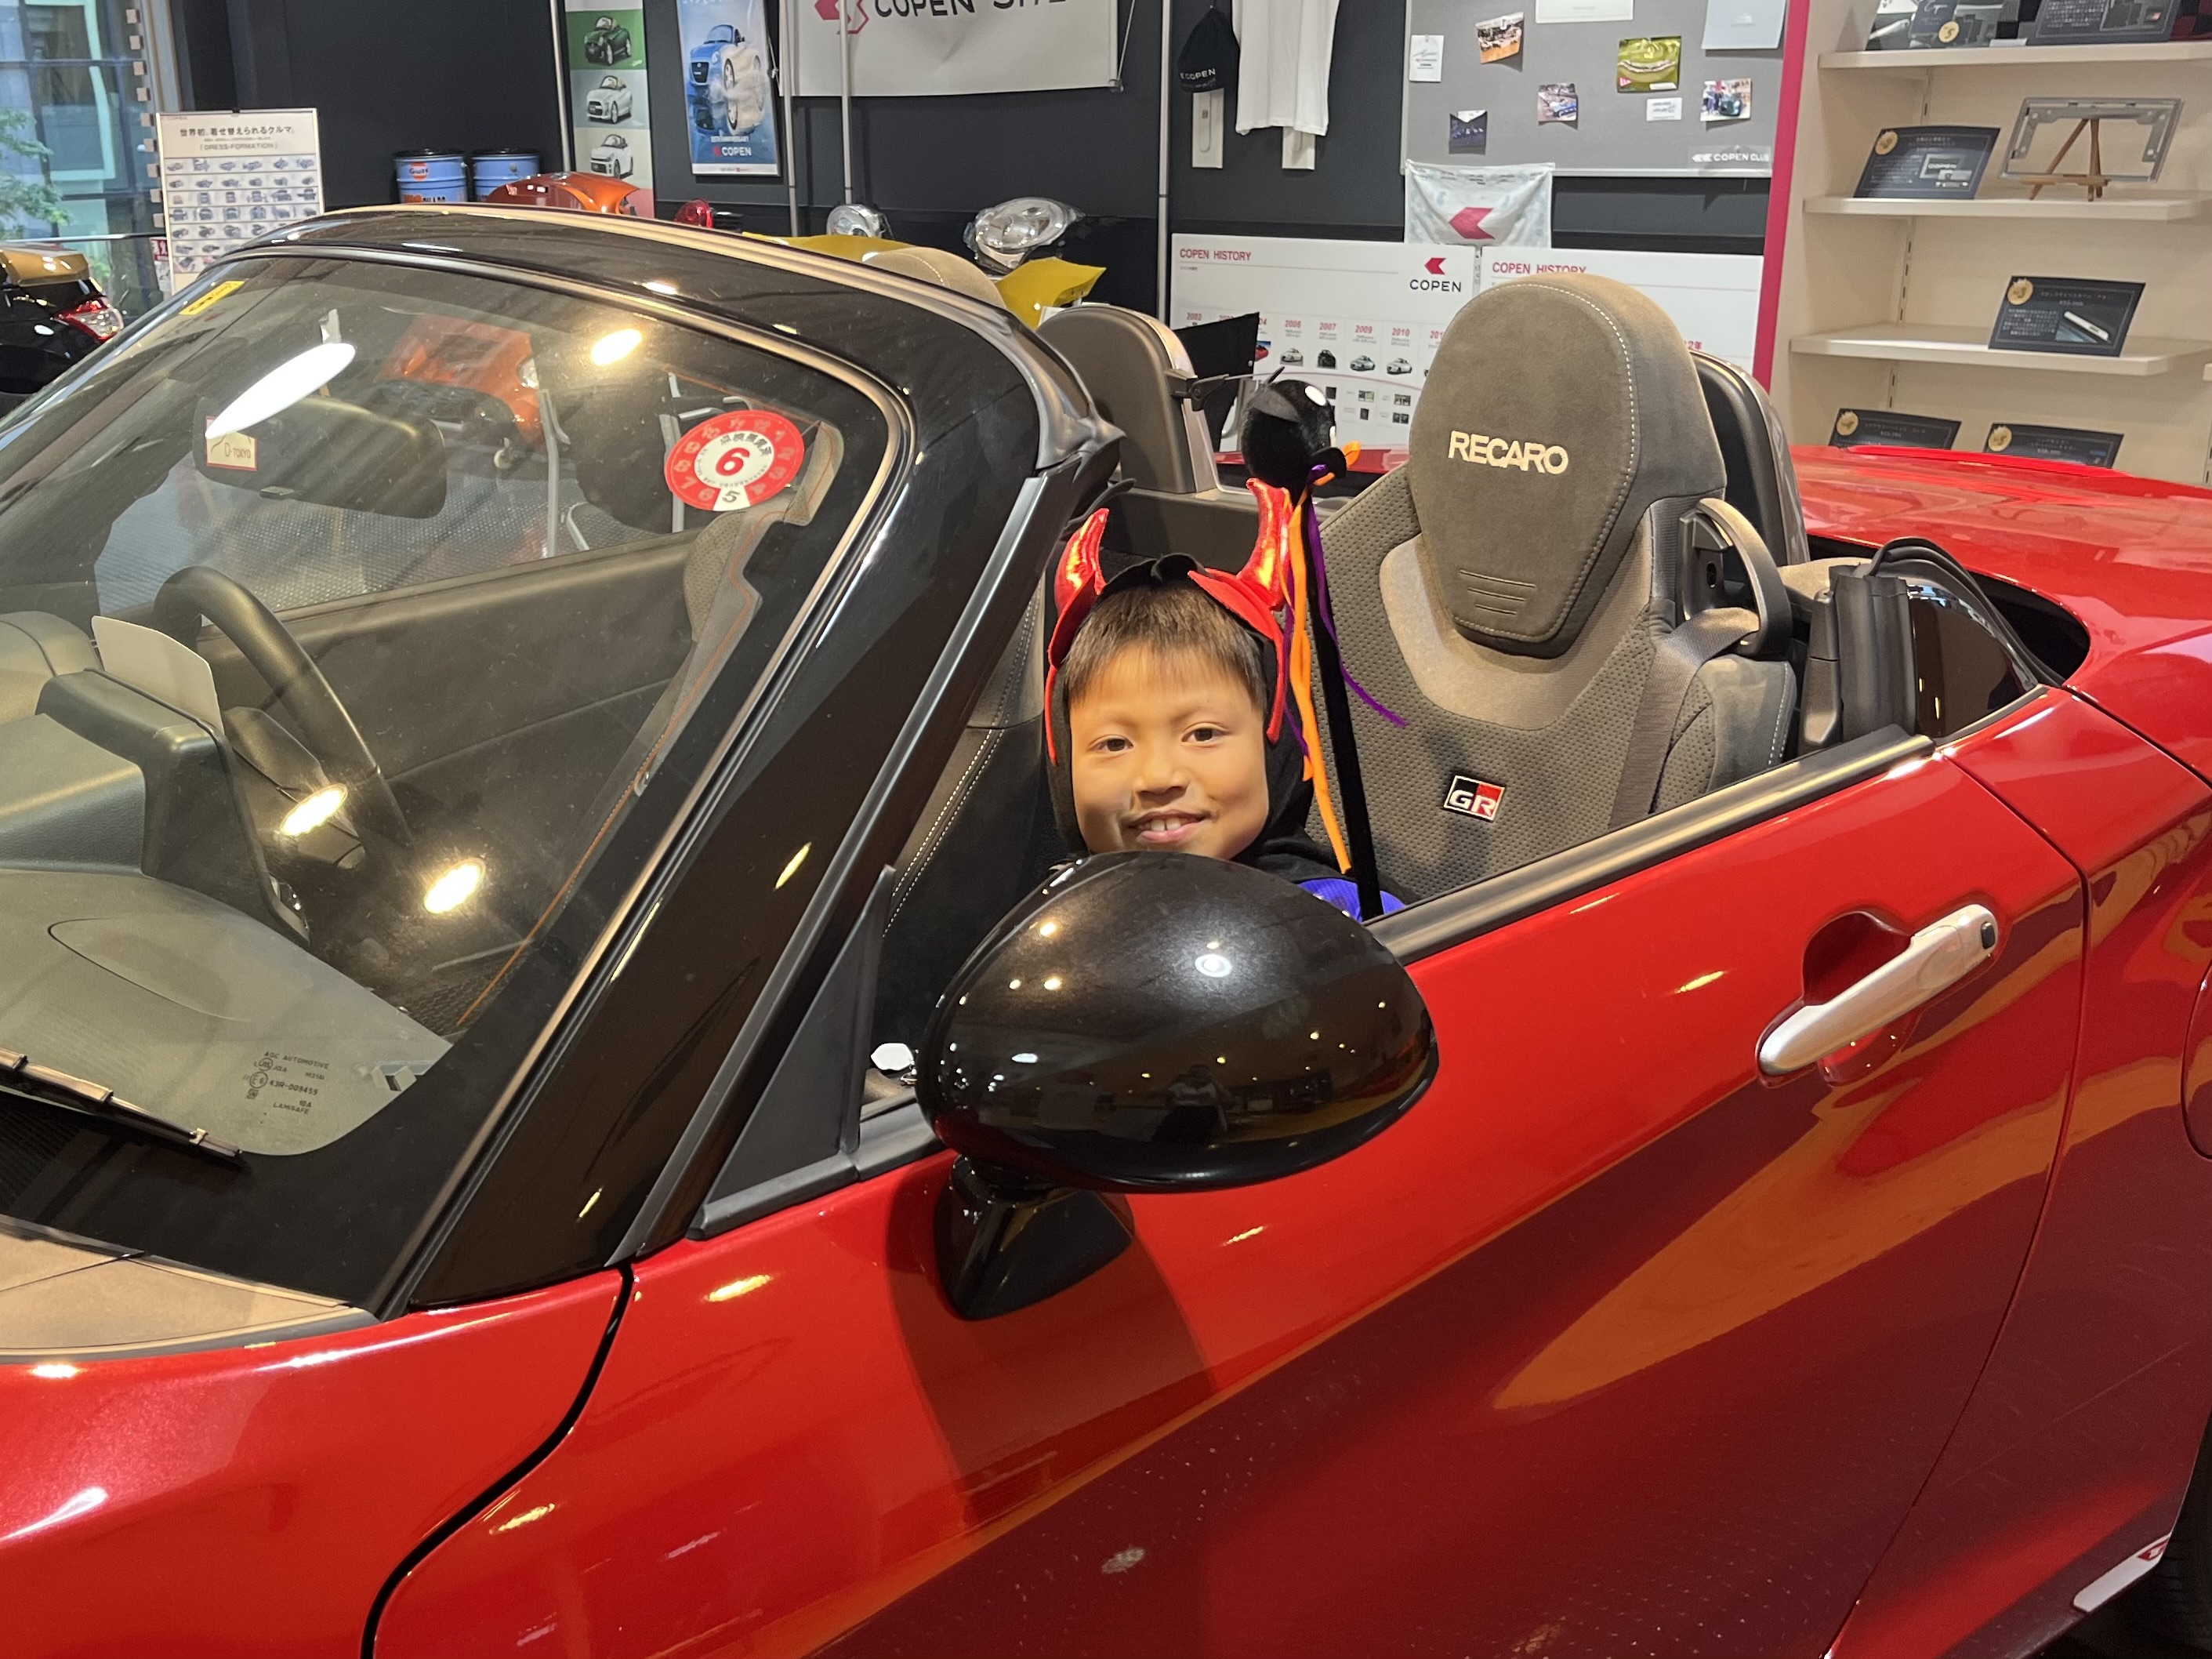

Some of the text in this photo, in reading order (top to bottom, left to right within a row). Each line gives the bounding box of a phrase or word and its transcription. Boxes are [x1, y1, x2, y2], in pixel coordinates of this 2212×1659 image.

[875, 0, 975, 17] COPEN
[1185, 67, 1216, 80] COPEN
[721, 147, 752, 156] COPEN
[1713, 153, 1749, 162] COPEN
[1180, 249, 1252, 262] COPEN HISTORY
[1492, 262, 1531, 274] COPEN
[1409, 279, 1462, 293] COPEN
[1391, 328, 1410, 337] 2010
[1448, 430, 1568, 475] RECARO
[716, 448, 751, 477] 6
[723, 491, 740, 503] 5
[1449, 790, 1496, 816] GR
[282, 1055, 330, 1069] AUTOMOTIVE
